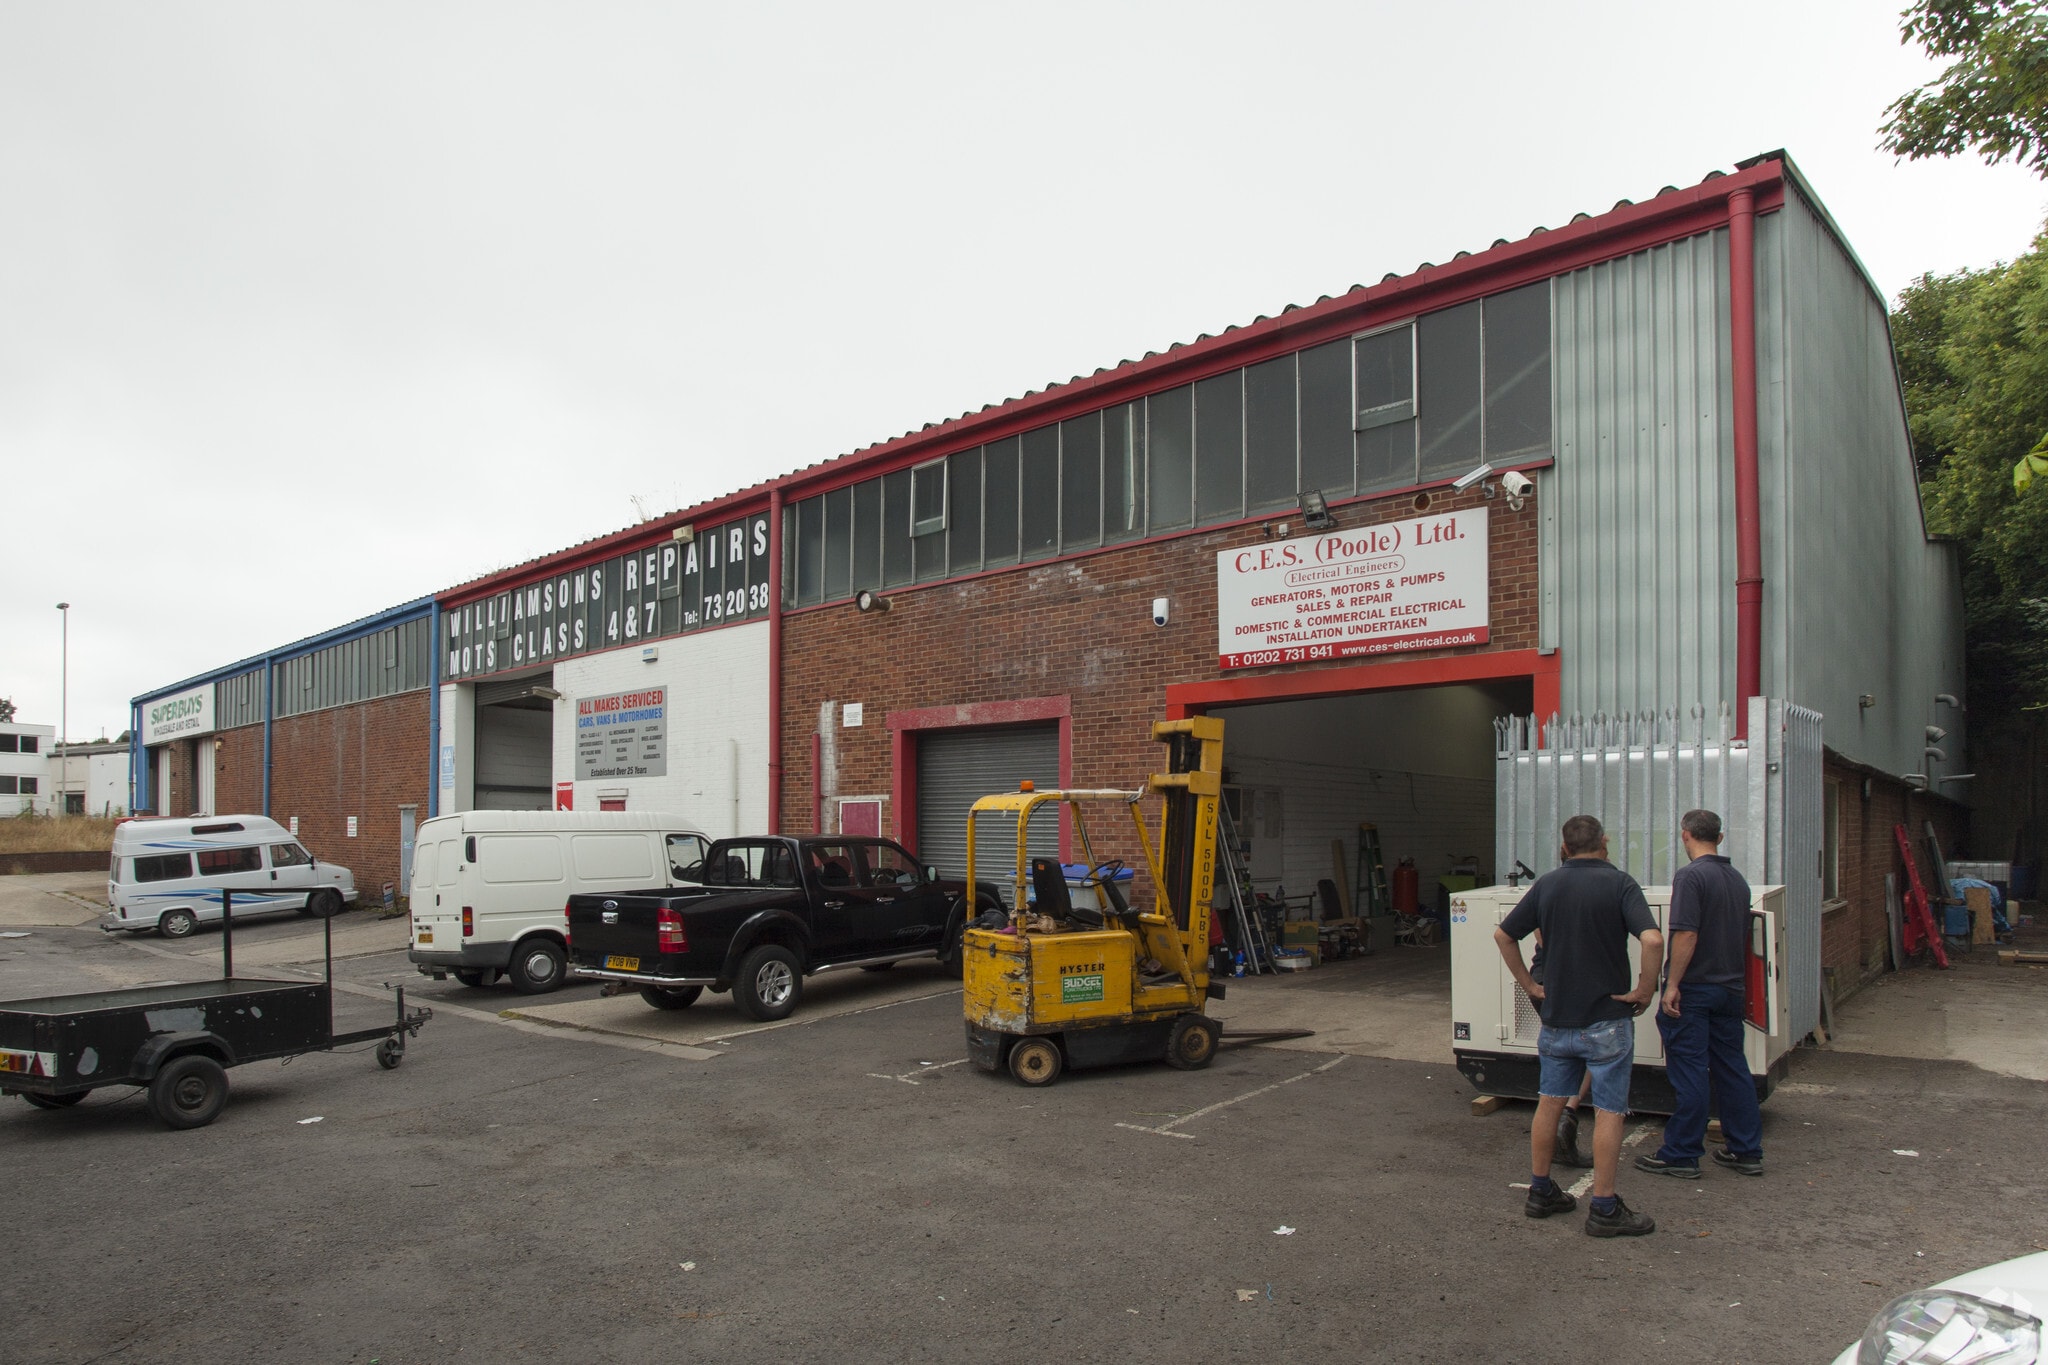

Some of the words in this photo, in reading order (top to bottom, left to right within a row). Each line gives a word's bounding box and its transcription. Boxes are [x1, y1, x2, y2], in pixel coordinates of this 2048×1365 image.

[1235, 545, 1304, 574] C.E.S.
[1315, 526, 1402, 564] (Poole)
[1416, 518, 1465, 546] Ltd.
[450, 570, 602, 637] WILLIAMSONS
[627, 520, 768, 591] REPAIRS
[1290, 567, 1340, 583] Electrical
[1346, 558, 1399, 576] Engineers
[1251, 588, 1326, 608] GENERATORS,
[1331, 580, 1380, 596] MOTORS
[1386, 578, 1394, 588] &
[1400, 572, 1445, 587] PUMPS
[1296, 600, 1331, 614] SALES
[1336, 598, 1345, 608] &
[1350, 592, 1392, 606] REPAIR
[684, 611, 698, 625] Tel:
[1235, 620, 1289, 636] DOMESTIC
[1294, 618, 1303, 628] &
[1307, 608, 1385, 627] COMMERCIAL
[1390, 598, 1466, 617] ELECTRICAL
[1266, 626, 1342, 645] INSTALLATION
[1348, 617, 1427, 635] UNDERTAKEN
[450, 640, 494, 676] MOTS
[514, 619, 584, 662] CLASS
[1228, 656, 1239, 667] T:
[1243, 650, 1280, 666] 01202
[1284, 648, 1305, 661] 731
[1310, 645, 1333, 659] 941
[1342, 632, 1476, 655] www.ces-electrical.co.uk
[151, 694, 203, 725] SUPERBUYS
[579, 701, 592, 715] ALL
[594, 696, 620, 713] MAKES
[622, 690, 663, 709] SERVICED
[185, 717, 200, 729] RETAIL
[579, 717, 595, 728] CARS,
[596, 714, 611, 726] VANS
[612, 714, 617, 724] &
[619, 708, 662, 723] MOTORHOMES
[591, 766, 615, 776] Established
[616, 767, 627, 775] Over
[628, 766, 633, 774] 25
[1202, 849, 1210, 899] 5000
[1198, 908, 1206, 944] LBS
[608, 956, 624, 967] FY08
[626, 957, 638, 968] VNR
[1060, 963, 1105, 974] HYSTER
[1064, 976, 1101, 988] BUDGET
